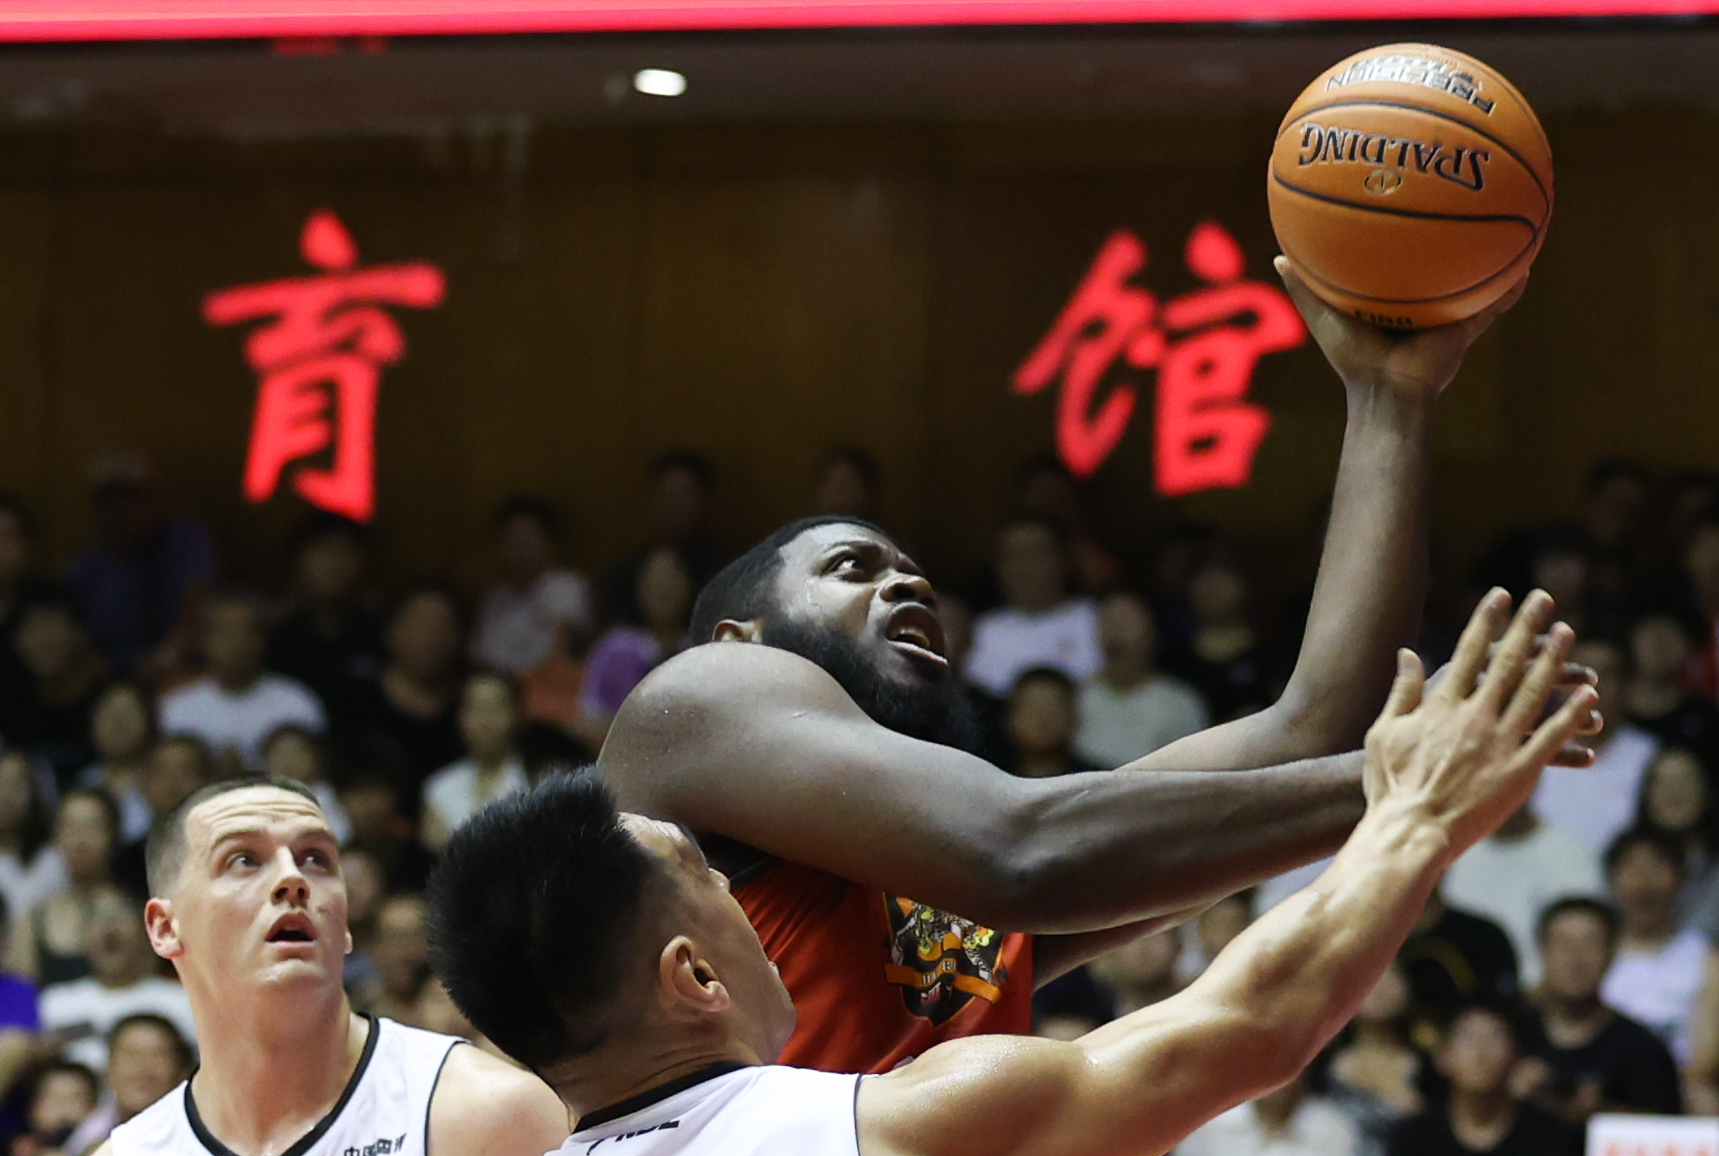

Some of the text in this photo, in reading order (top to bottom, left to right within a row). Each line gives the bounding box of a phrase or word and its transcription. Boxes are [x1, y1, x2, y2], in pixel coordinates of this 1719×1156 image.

[1298, 121, 1491, 192] SPALDING
[203, 208, 1307, 524] 育 馆
